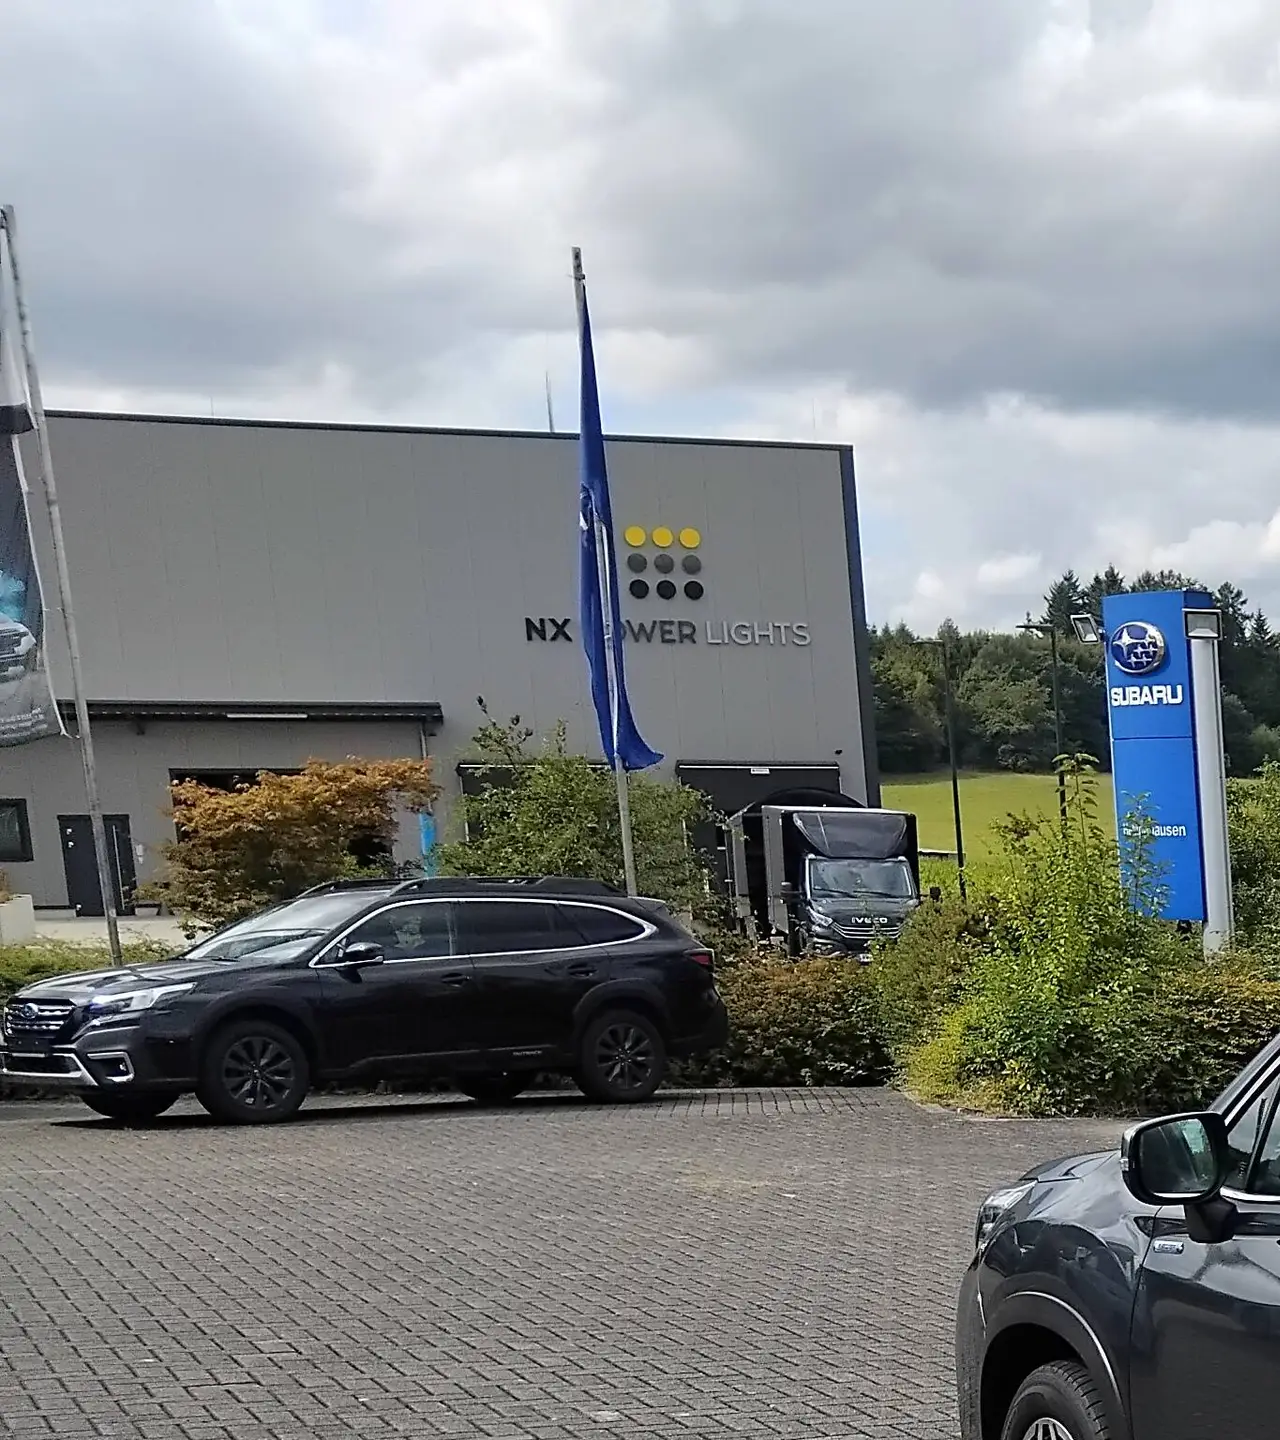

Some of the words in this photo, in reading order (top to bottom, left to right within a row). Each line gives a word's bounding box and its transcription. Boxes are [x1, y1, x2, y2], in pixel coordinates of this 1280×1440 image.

[524, 617, 572, 642] NX
[619, 619, 697, 644] WER
[705, 620, 812, 646] LIGHTS
[1110, 685, 1183, 706] SUBARU
